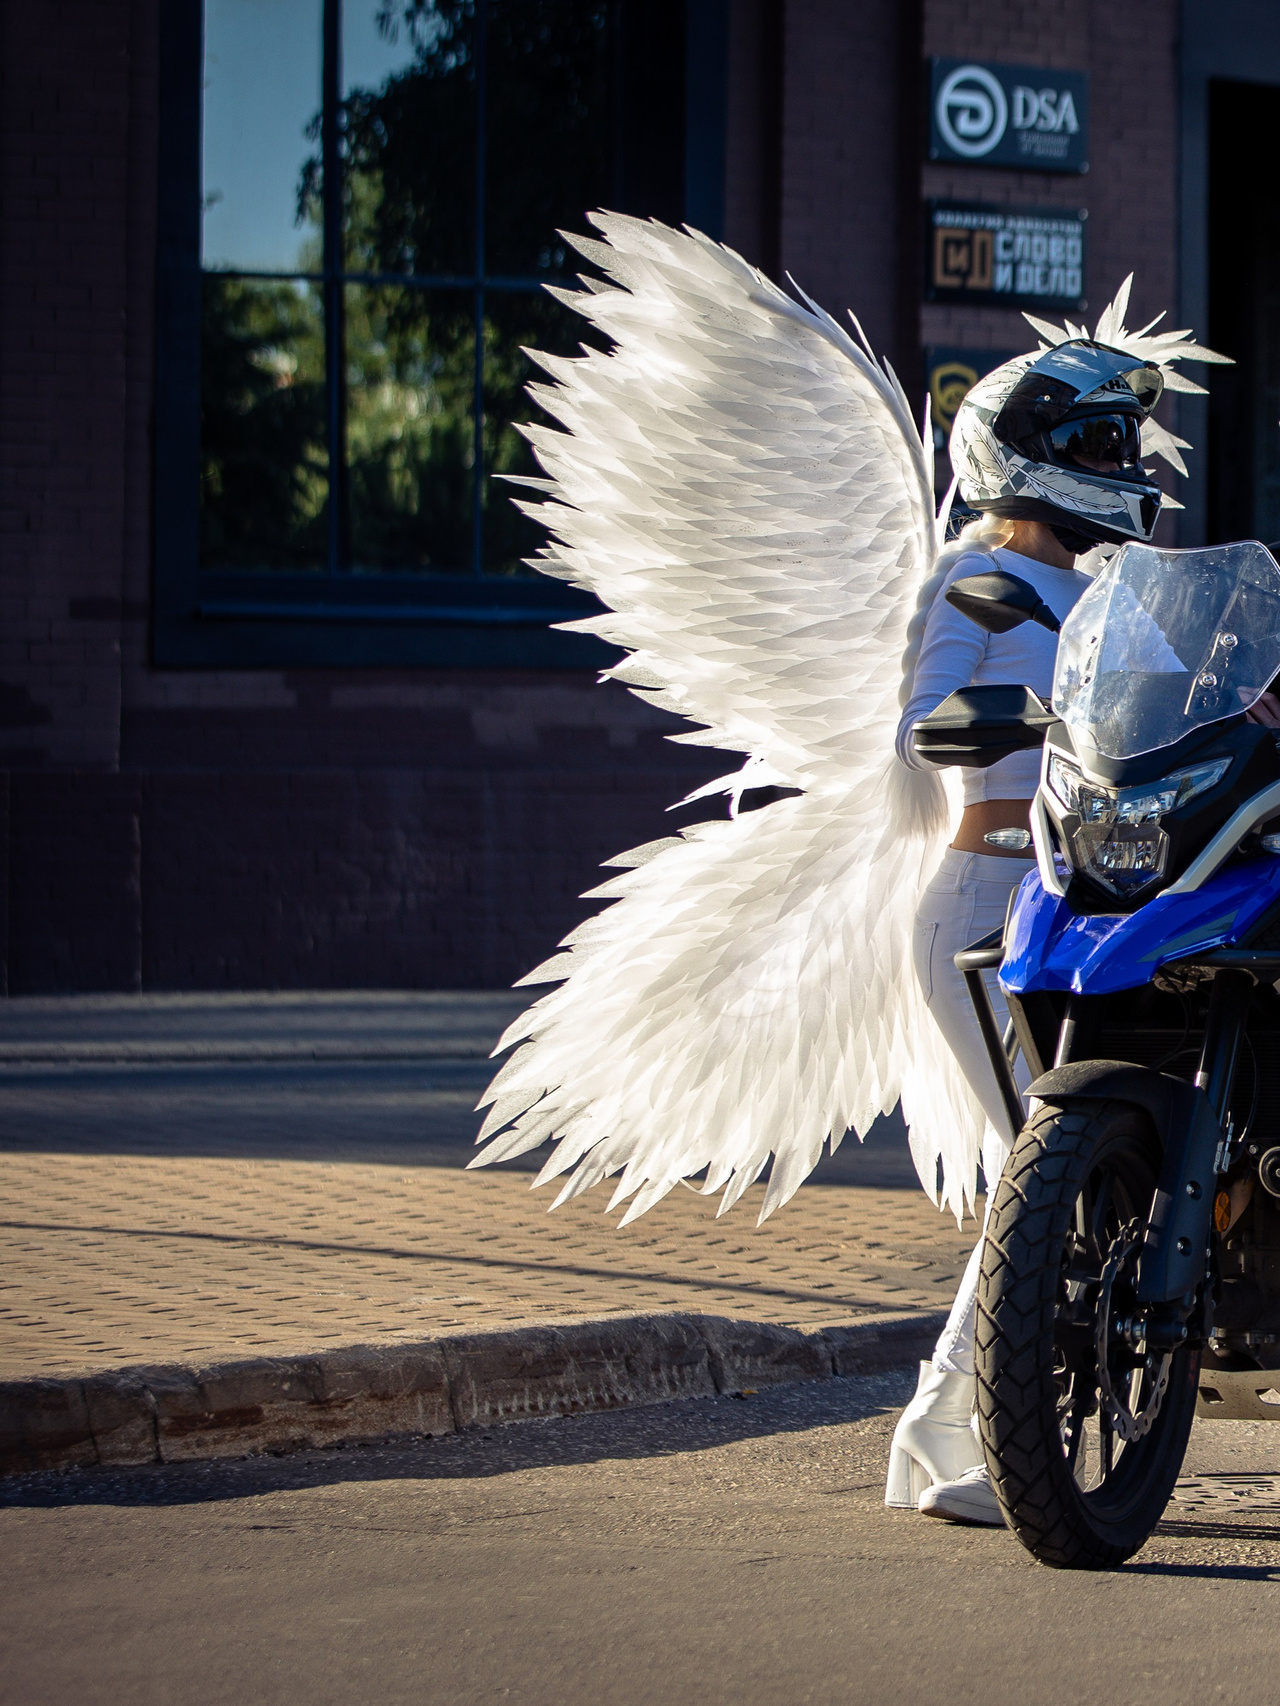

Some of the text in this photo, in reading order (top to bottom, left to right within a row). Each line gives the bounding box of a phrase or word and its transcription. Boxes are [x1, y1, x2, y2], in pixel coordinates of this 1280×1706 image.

[1013, 85, 1080, 133] DSA
[995, 230, 1082, 266] СЛОВО
[994, 263, 1082, 298] И ДЕЛО
